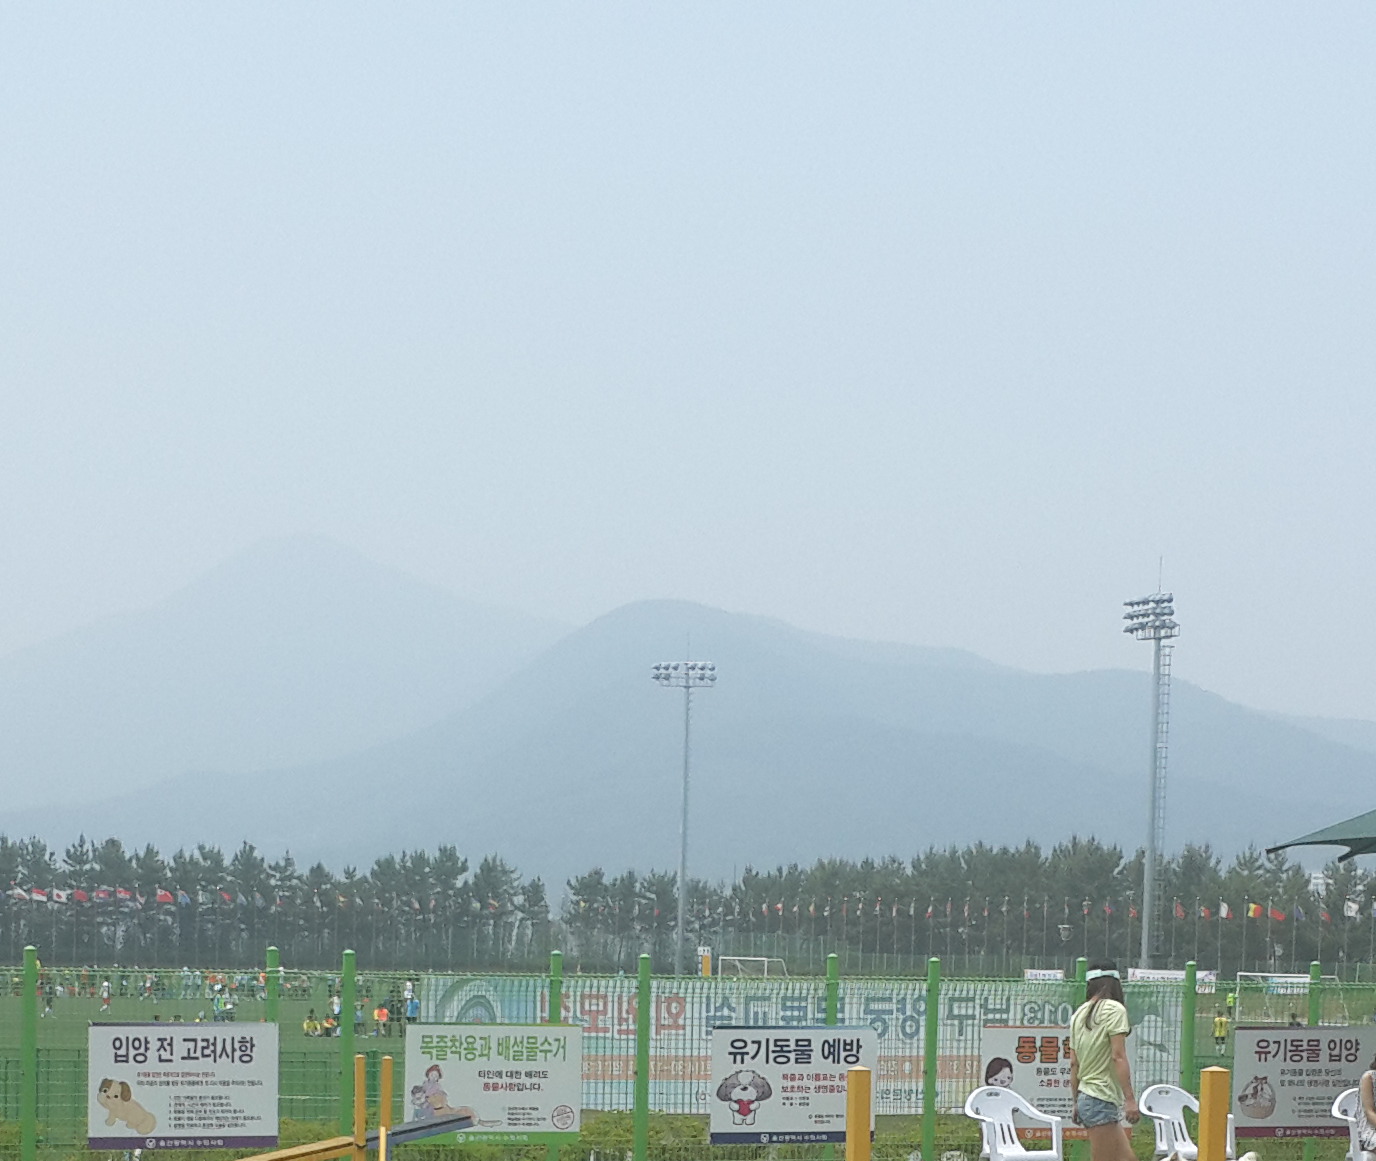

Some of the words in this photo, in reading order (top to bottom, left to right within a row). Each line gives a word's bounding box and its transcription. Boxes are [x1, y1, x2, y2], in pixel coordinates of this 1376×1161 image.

[112, 1036, 150, 1064] 입양
[156, 1036, 174, 1063] 전
[180, 1036, 256, 1064] 고려사항
[419, 1034, 492, 1062] 목줄착용과
[497, 1035, 567, 1062] 배설물수거
[728, 1038, 813, 1065] 유기동물
[821, 1037, 863, 1065] 예방
[1254, 1039, 1322, 1063] 유기동물
[1328, 1038, 1360, 1063] 입양
[478, 1070, 503, 1079] 타인에
[505, 1070, 522, 1079] 대한
[524, 1070, 549, 1079] 배려도
